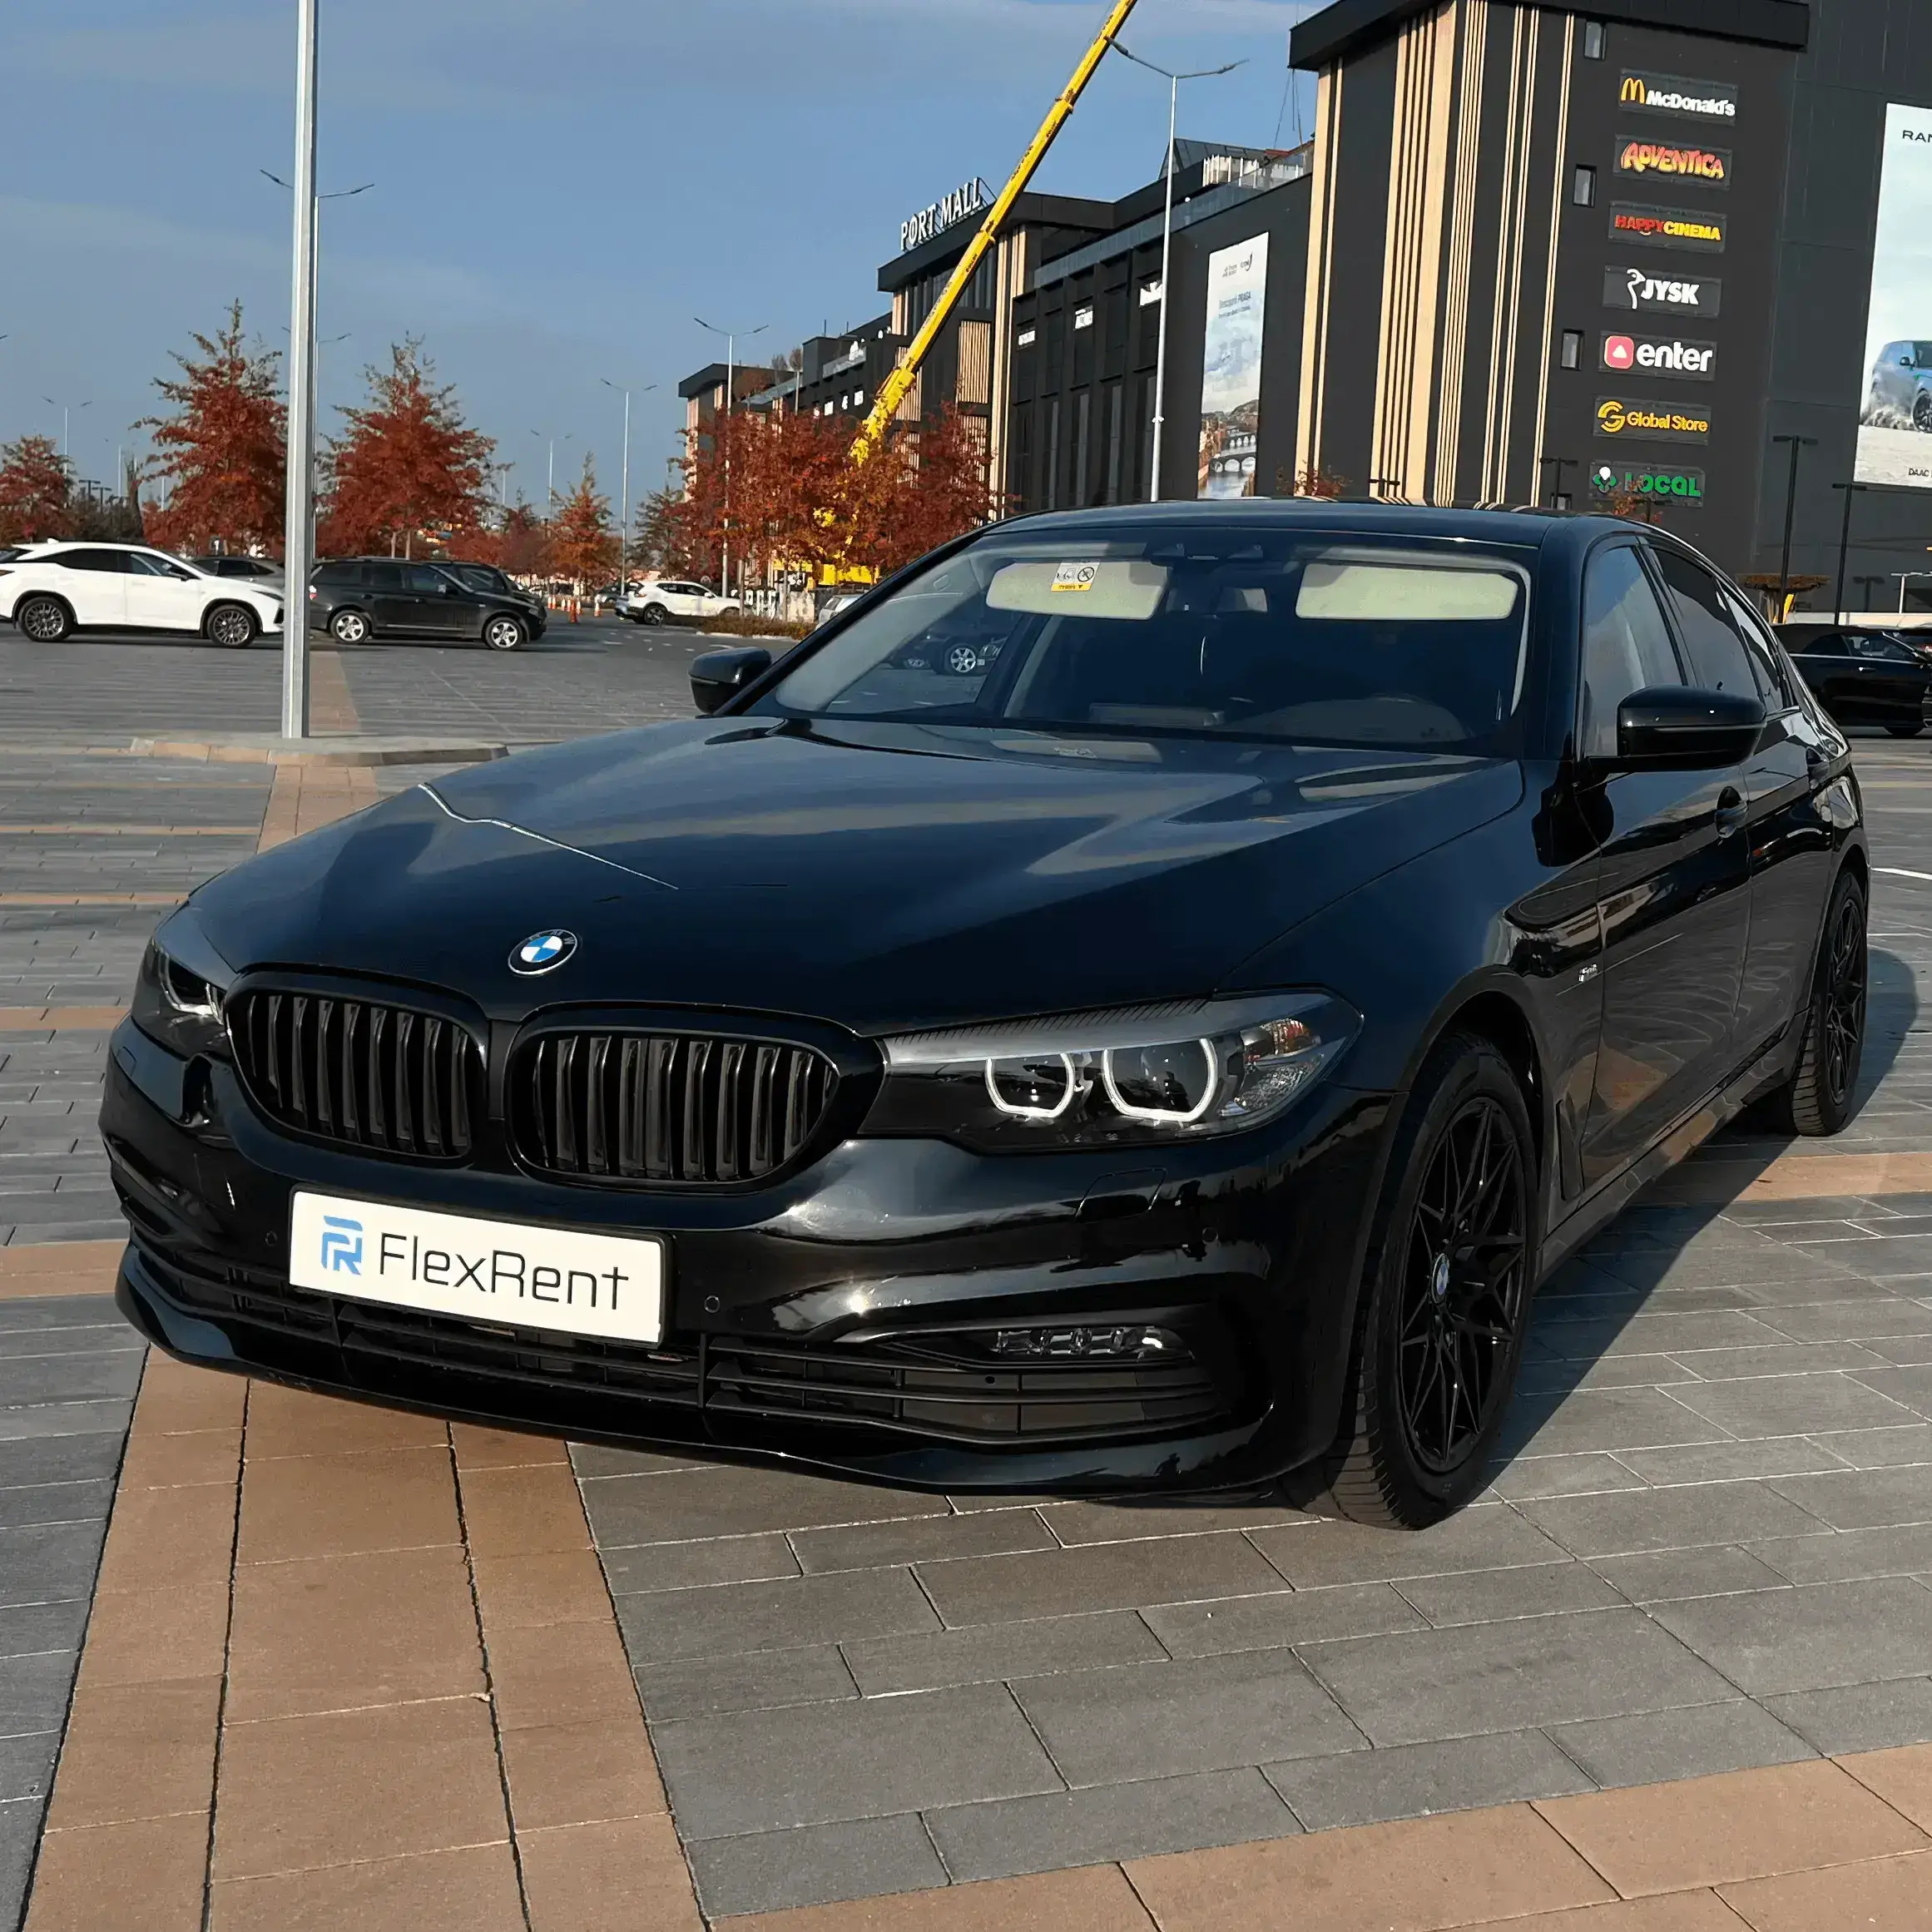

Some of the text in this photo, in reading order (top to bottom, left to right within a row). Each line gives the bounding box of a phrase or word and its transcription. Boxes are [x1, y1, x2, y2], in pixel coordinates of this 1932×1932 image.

[1646, 90, 1736, 116] McDonald's
[901, 176, 981, 251] PORT MALL
[1641, 279, 1700, 305] JYSK
[1637, 341, 1713, 372] enter
[1627, 411, 1670, 429] Global
[1671, 415, 1708, 432] Store
[379, 1231, 630, 1310] FlexRent
